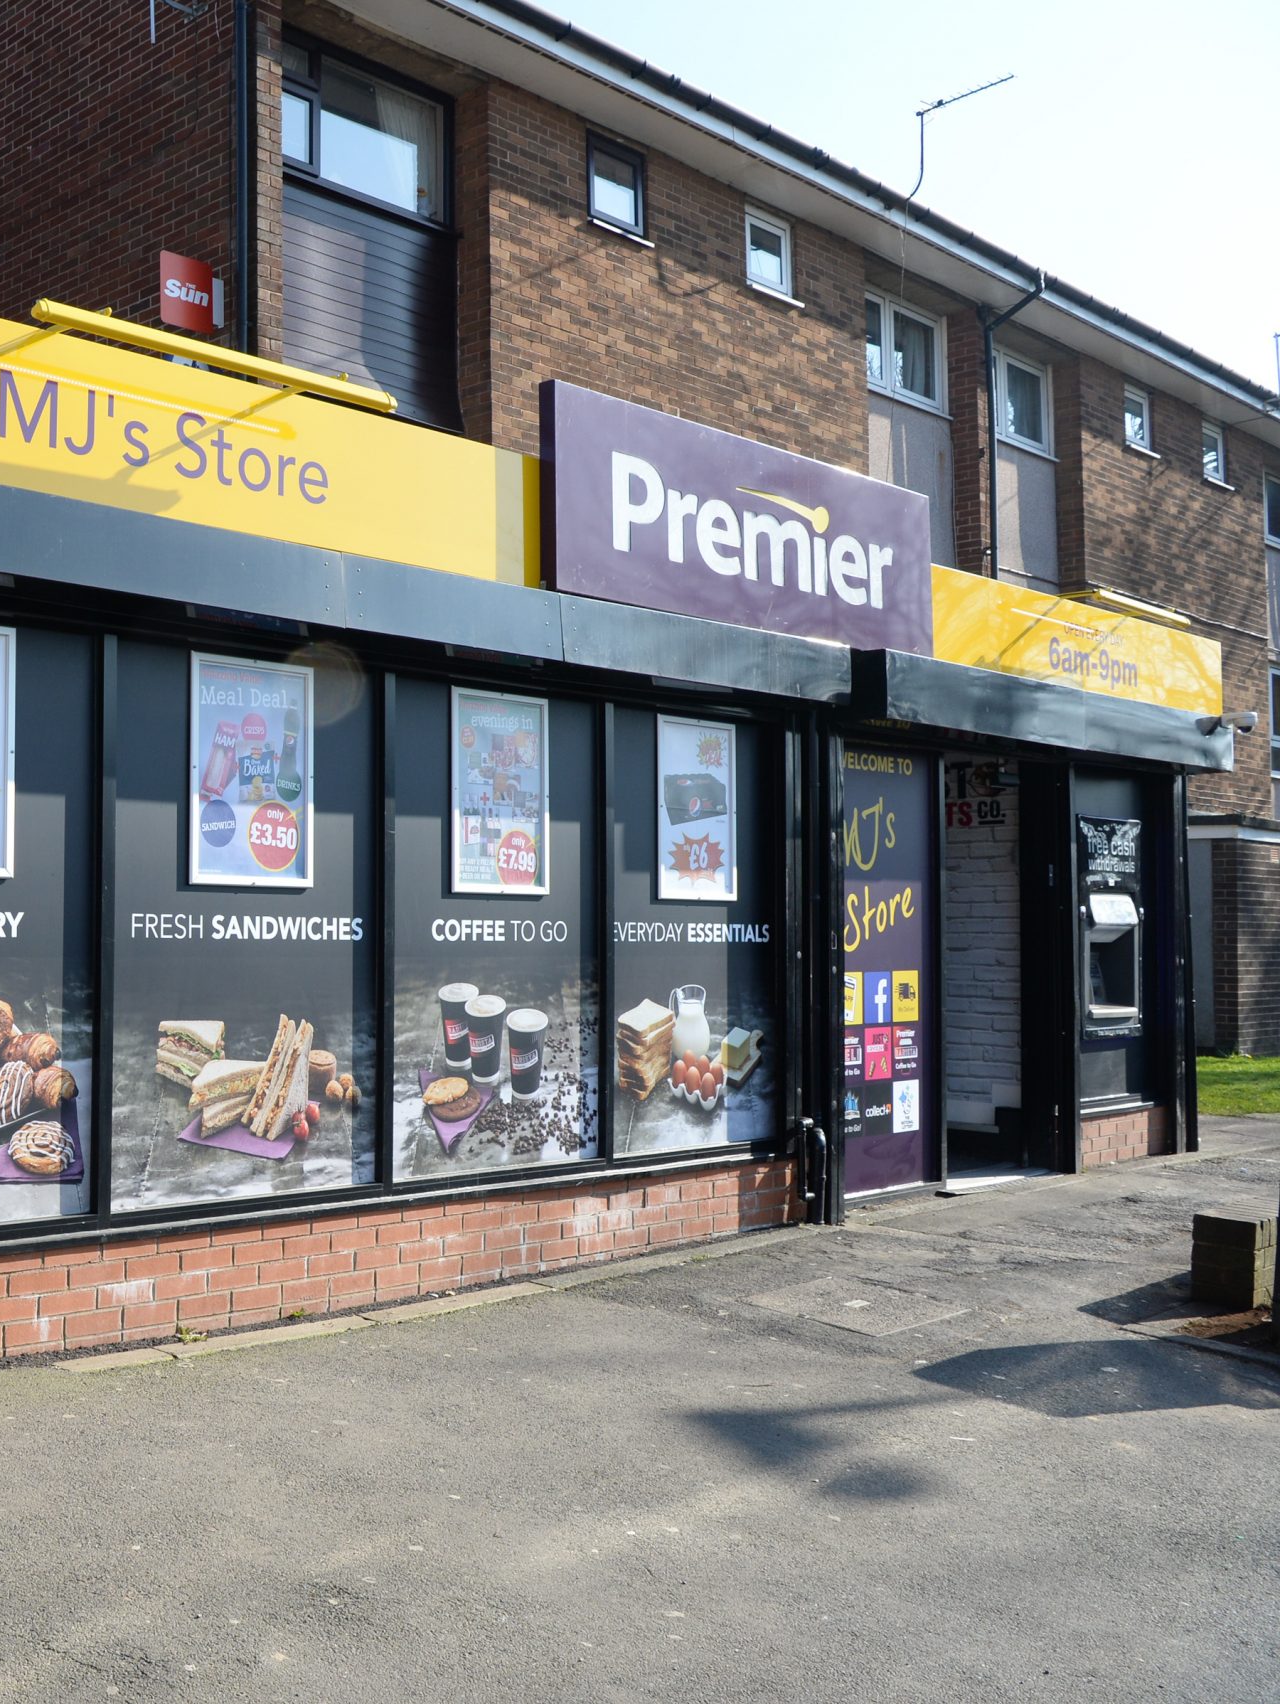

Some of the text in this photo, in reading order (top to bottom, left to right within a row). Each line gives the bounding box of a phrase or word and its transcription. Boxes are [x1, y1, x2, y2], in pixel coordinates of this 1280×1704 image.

[163, 278, 209, 307] Sun
[174, 411, 330, 505] Store
[611, 450, 894, 610] Premier
[1048, 636, 1138, 690] 6am-9pm
[200, 685, 245, 706] Meal
[244, 726, 265, 736] CRISPS
[471, 713, 533, 732] evenings in
[215, 732, 236, 748] HAM
[243, 759, 271, 776] Baked
[897, 758, 913, 776] TO
[277, 778, 301, 792] DRINKS
[267, 809, 284, 823] only
[977, 800, 1007, 819] CO.
[201, 819, 236, 833] SANDWICH
[250, 822, 297, 850] £3.50
[511, 837, 526, 849] only
[1087, 837, 1136, 857] free cash
[498, 847, 537, 873] £7.99
[689, 842, 709, 870] £6
[1088, 857, 1136, 873] withdrawals
[131, 912, 364, 942] FRESH SANDWICHES
[843, 885, 915, 953] Store
[431, 918, 568, 943] COFFEE TO GO
[613, 921, 770, 943] EVERYDAY ESSENTIALS
